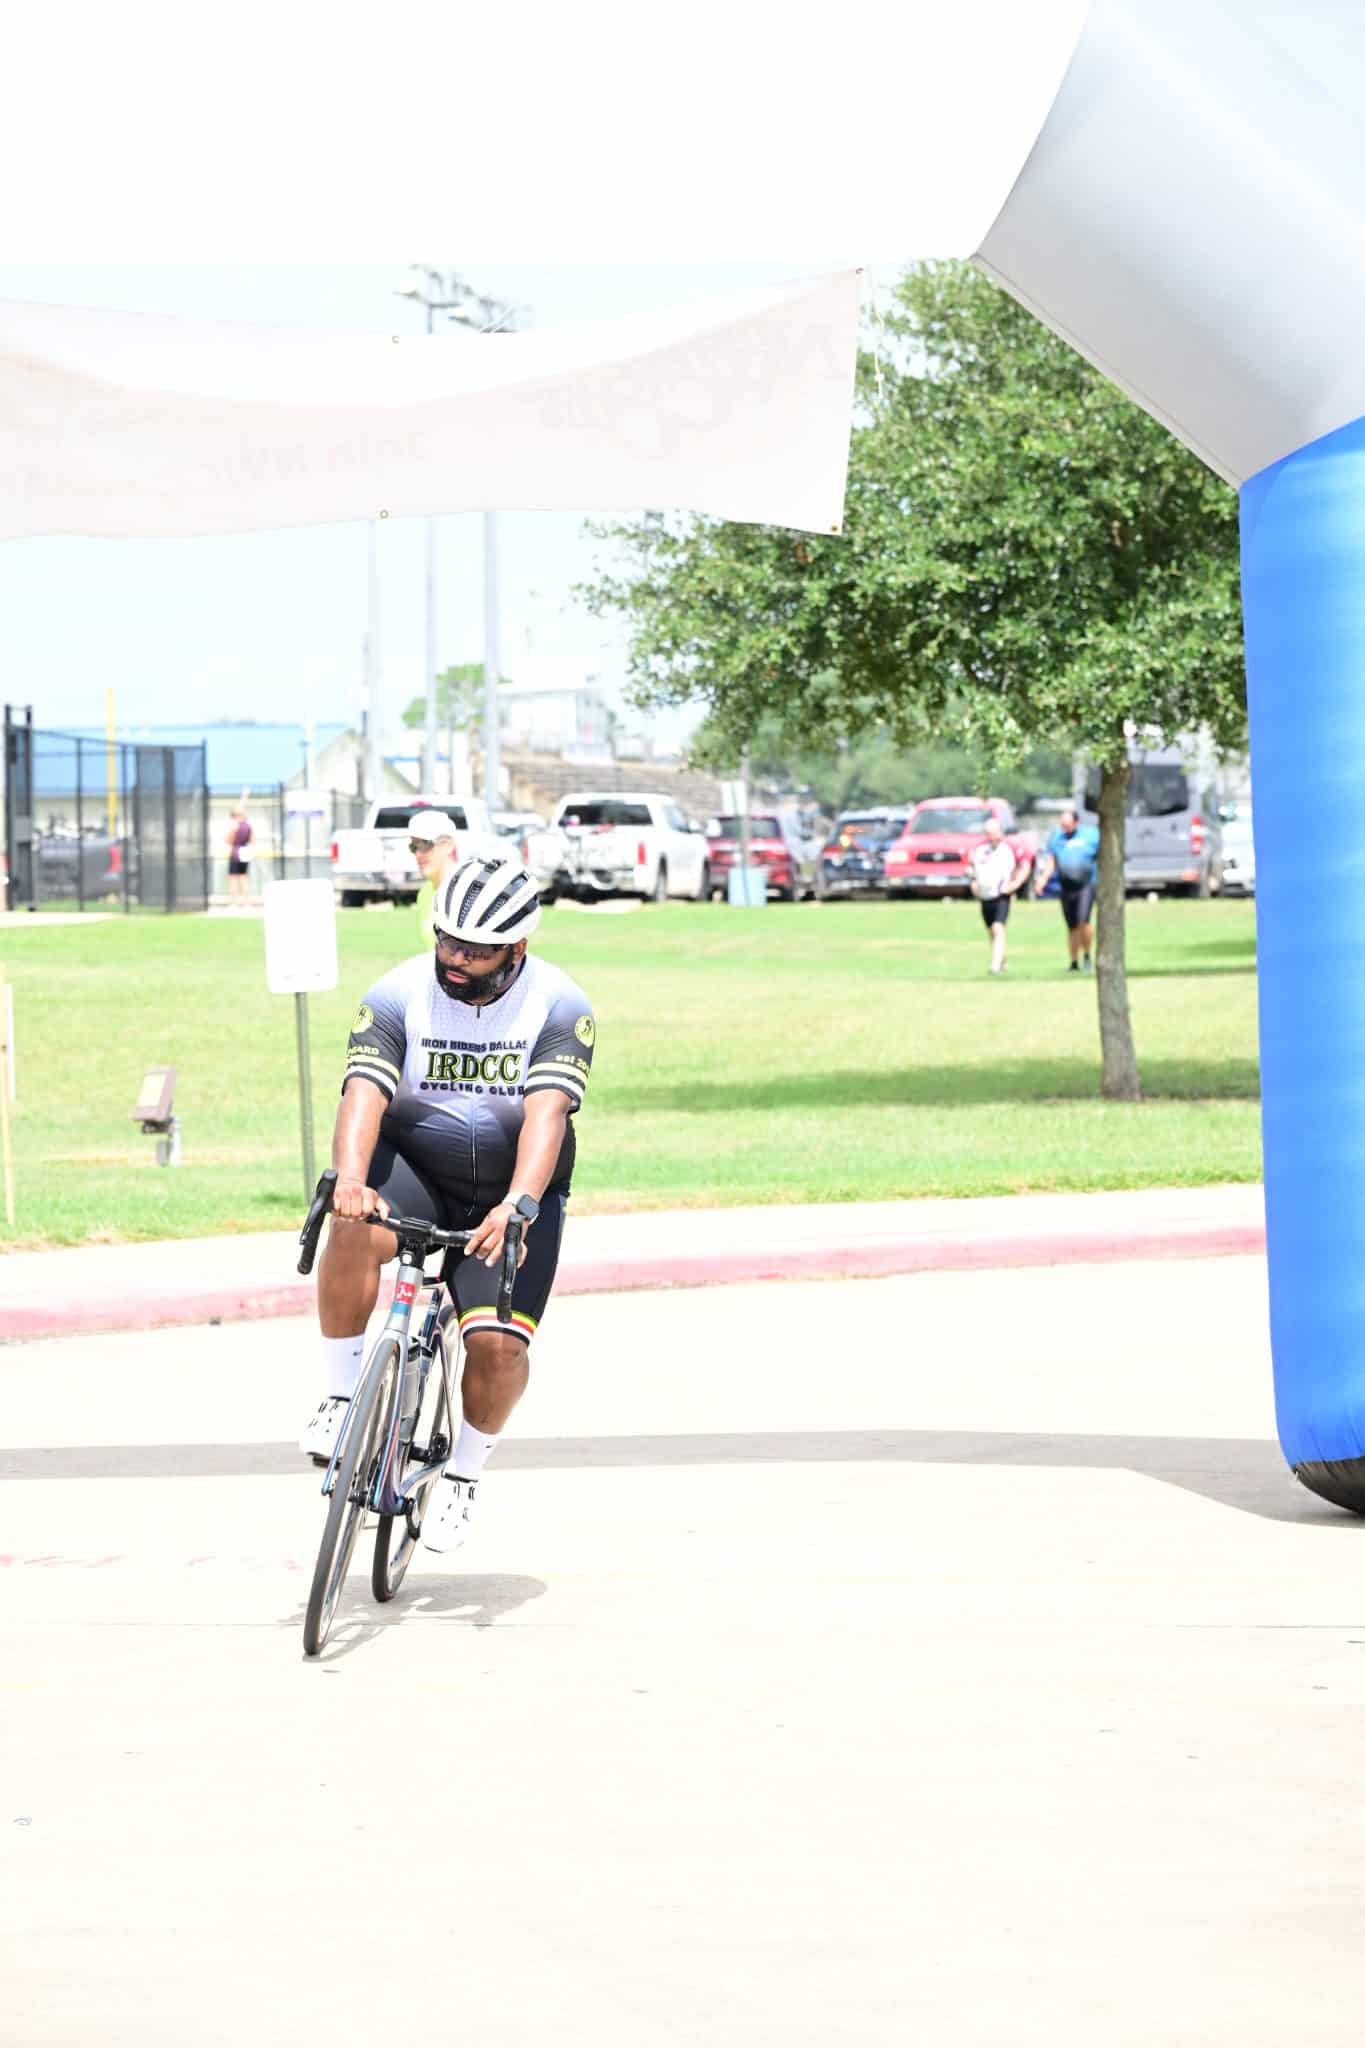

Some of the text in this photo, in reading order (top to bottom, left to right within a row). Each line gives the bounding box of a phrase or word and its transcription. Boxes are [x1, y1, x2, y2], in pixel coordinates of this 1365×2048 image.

[421, 1038, 447, 1049] IRON
[450, 1039, 486, 1052] RIDERS
[425, 1051, 521, 1084] IRDCC
[420, 1081, 525, 1097] CYCLING CLUB
